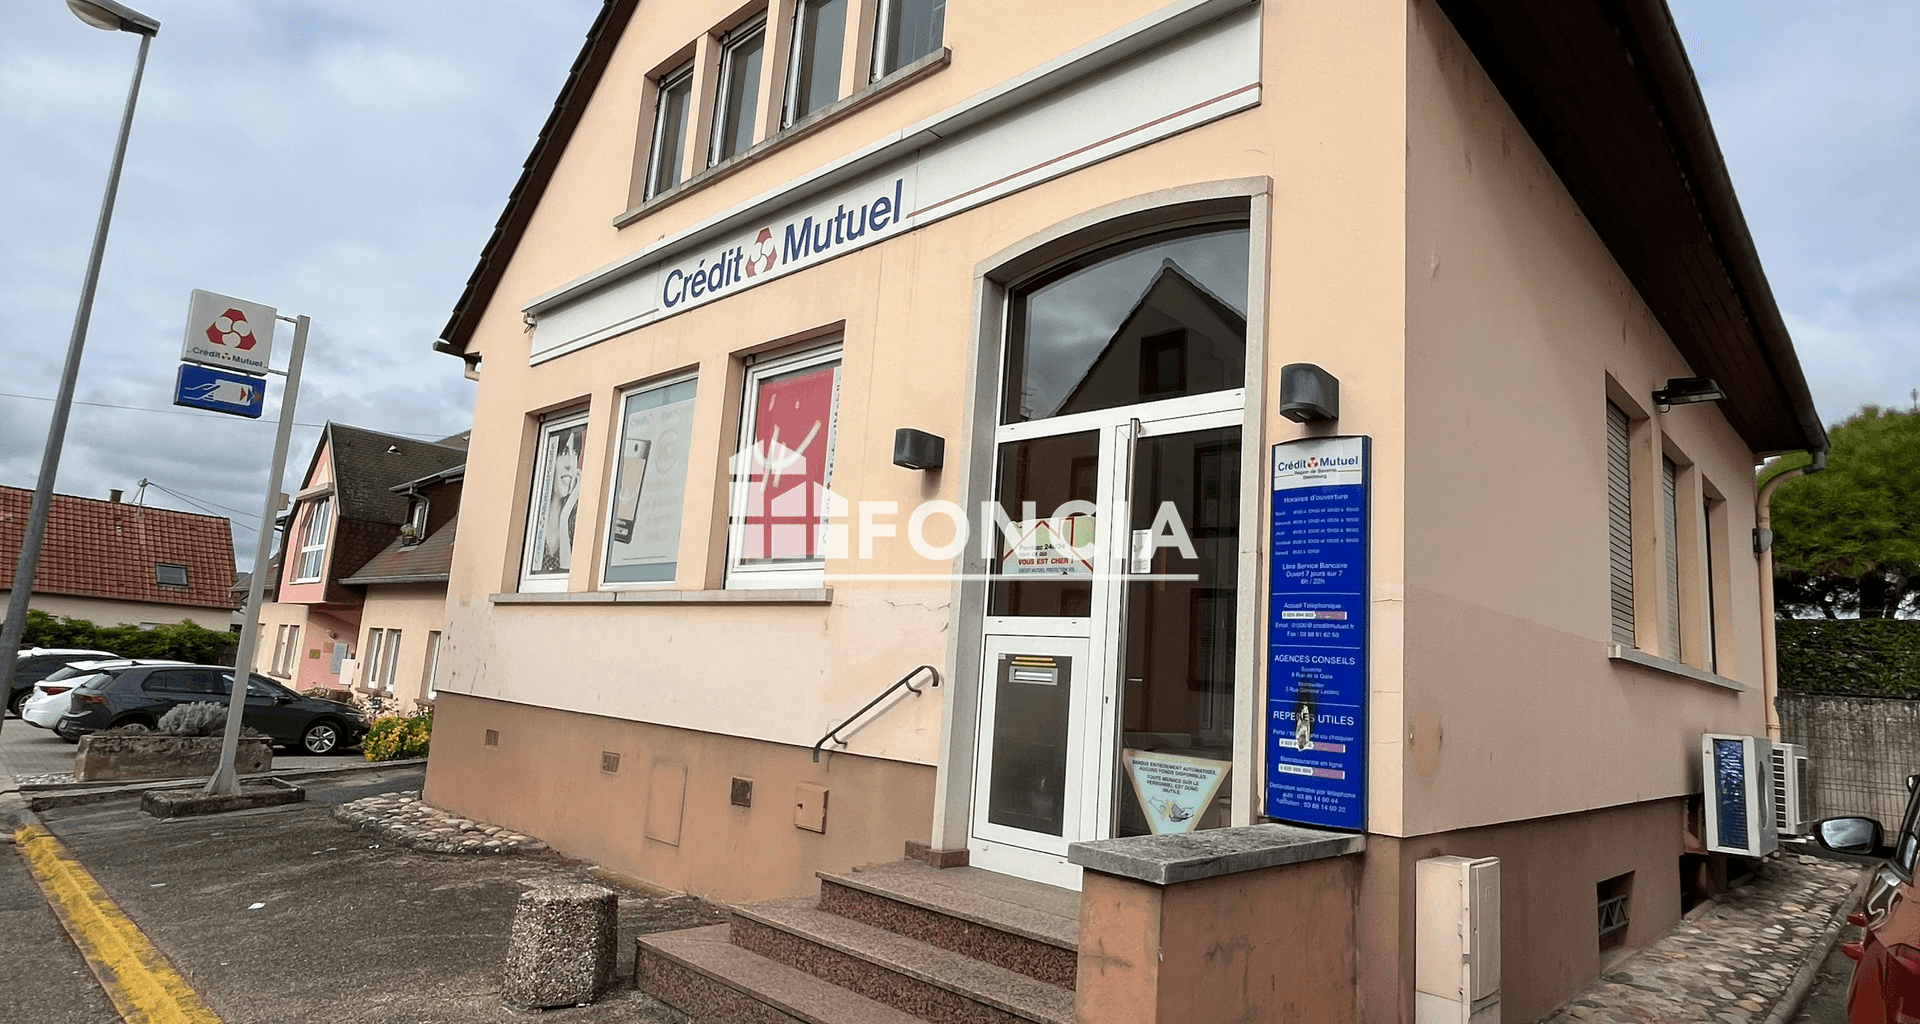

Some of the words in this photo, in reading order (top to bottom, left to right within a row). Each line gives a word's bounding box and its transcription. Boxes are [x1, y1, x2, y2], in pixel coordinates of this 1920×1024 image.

[663, 246, 743, 308] Crédit
[782, 179, 903, 265] Mutuel
[192, 347, 221, 359] Crédit
[232, 355, 263, 367] Mutuel
[1278, 460, 1306, 471] Crédit
[1320, 456, 1358, 466] Mutuel
[1283, 495, 1308, 503] Horaires
[1274, 654, 1310, 663] AGENCES
[1311, 655, 1356, 665] CONSEILS
[1317, 714, 1355, 726] UTILES
